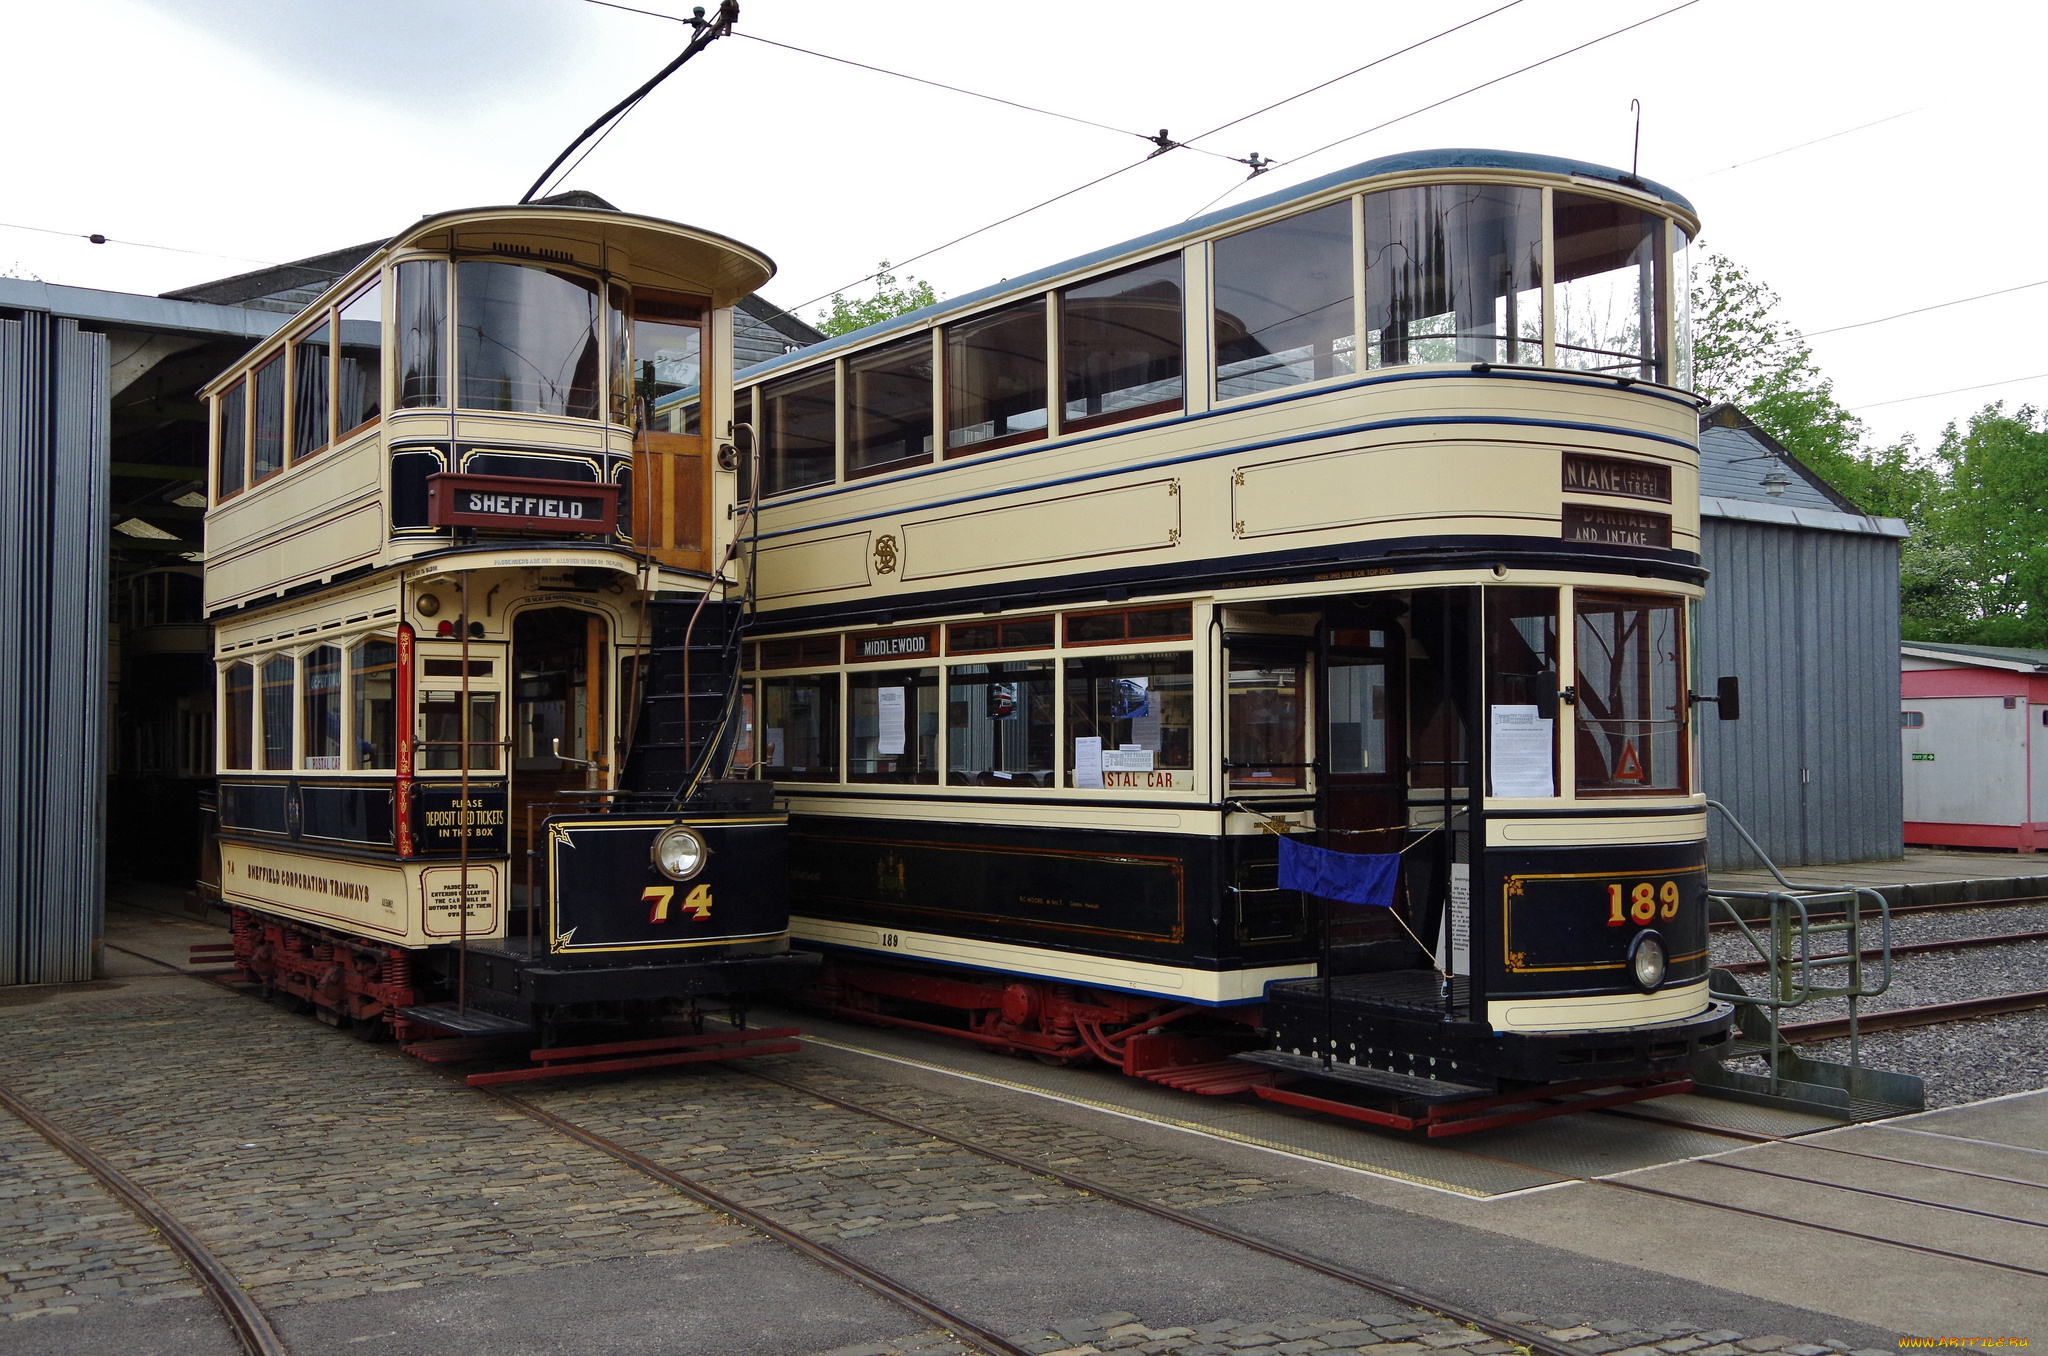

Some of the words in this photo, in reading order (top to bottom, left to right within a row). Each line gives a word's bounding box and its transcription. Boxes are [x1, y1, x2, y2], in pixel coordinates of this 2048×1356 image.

[470, 493, 583, 519] SHEFFIELD
[1576, 528, 1598, 541] AND
[1329, 572, 1341, 580] THIS
[1380, 568, 1394, 576] DECK
[864, 637, 926, 656] MIDDLEWOOD
[1148, 772, 1172, 787] CAR
[426, 811, 456, 826] DEPOSIT
[458, 811, 474, 825] UED
[476, 810, 504, 825] TICKETS
[439, 829, 450, 837] IN
[452, 828, 472, 837] THS
[476, 828, 493, 836] BOX
[248, 864, 280, 885] SHEFFIELD
[282, 870, 328, 894] CORPORATION
[330, 880, 369, 903] TRAMWAYS
[641, 884, 713, 924] 74
[1606, 881, 1679, 927] 189
[882, 934, 898, 947] 189
